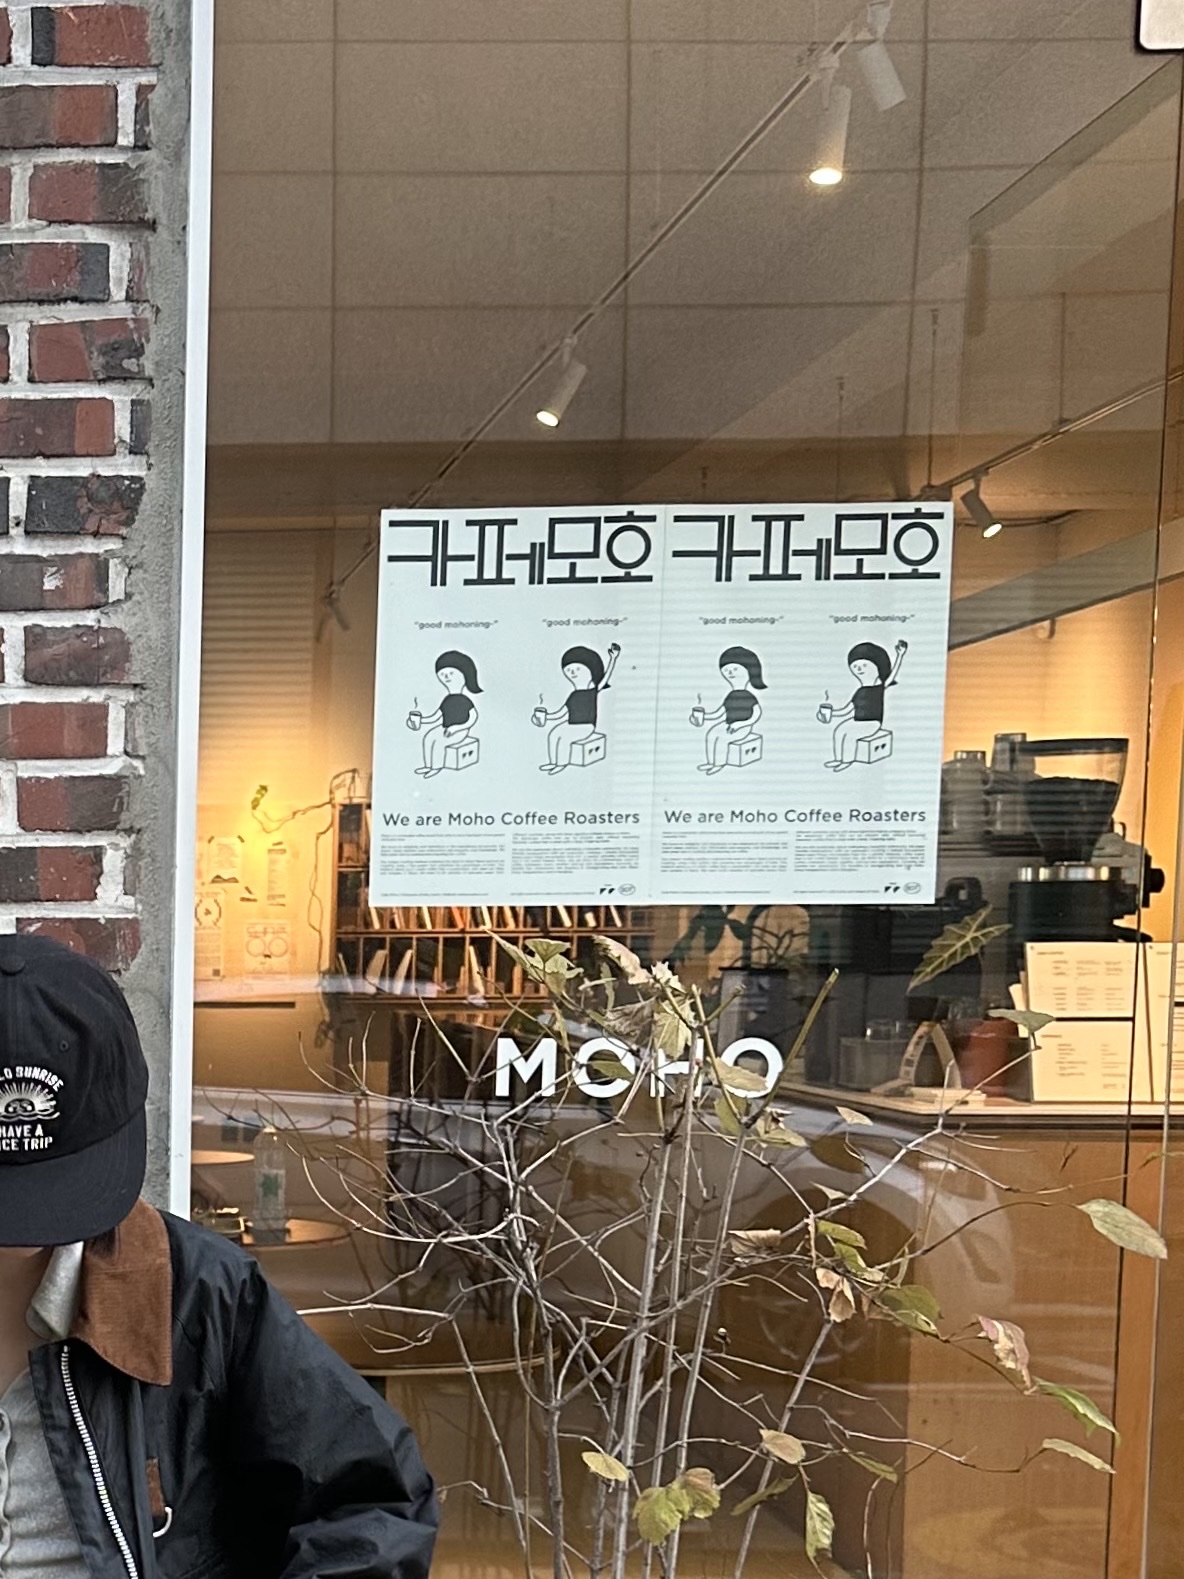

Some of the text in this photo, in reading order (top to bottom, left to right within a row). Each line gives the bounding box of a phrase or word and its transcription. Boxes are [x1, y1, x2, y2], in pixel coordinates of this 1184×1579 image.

[387, 510, 657, 587] 카페모호
[672, 507, 945, 583] 카페모호
[382, 810, 641, 827] We are Moho Coffee Roasters
[664, 808, 927, 824] We are Moho Coffee Roasters
[15, 1065, 65, 1092] SUNRISE
[494, 1036, 784, 1099] MOHO
[34, 1123, 44, 1137] A
[22, 1135, 54, 1151] TRIP
